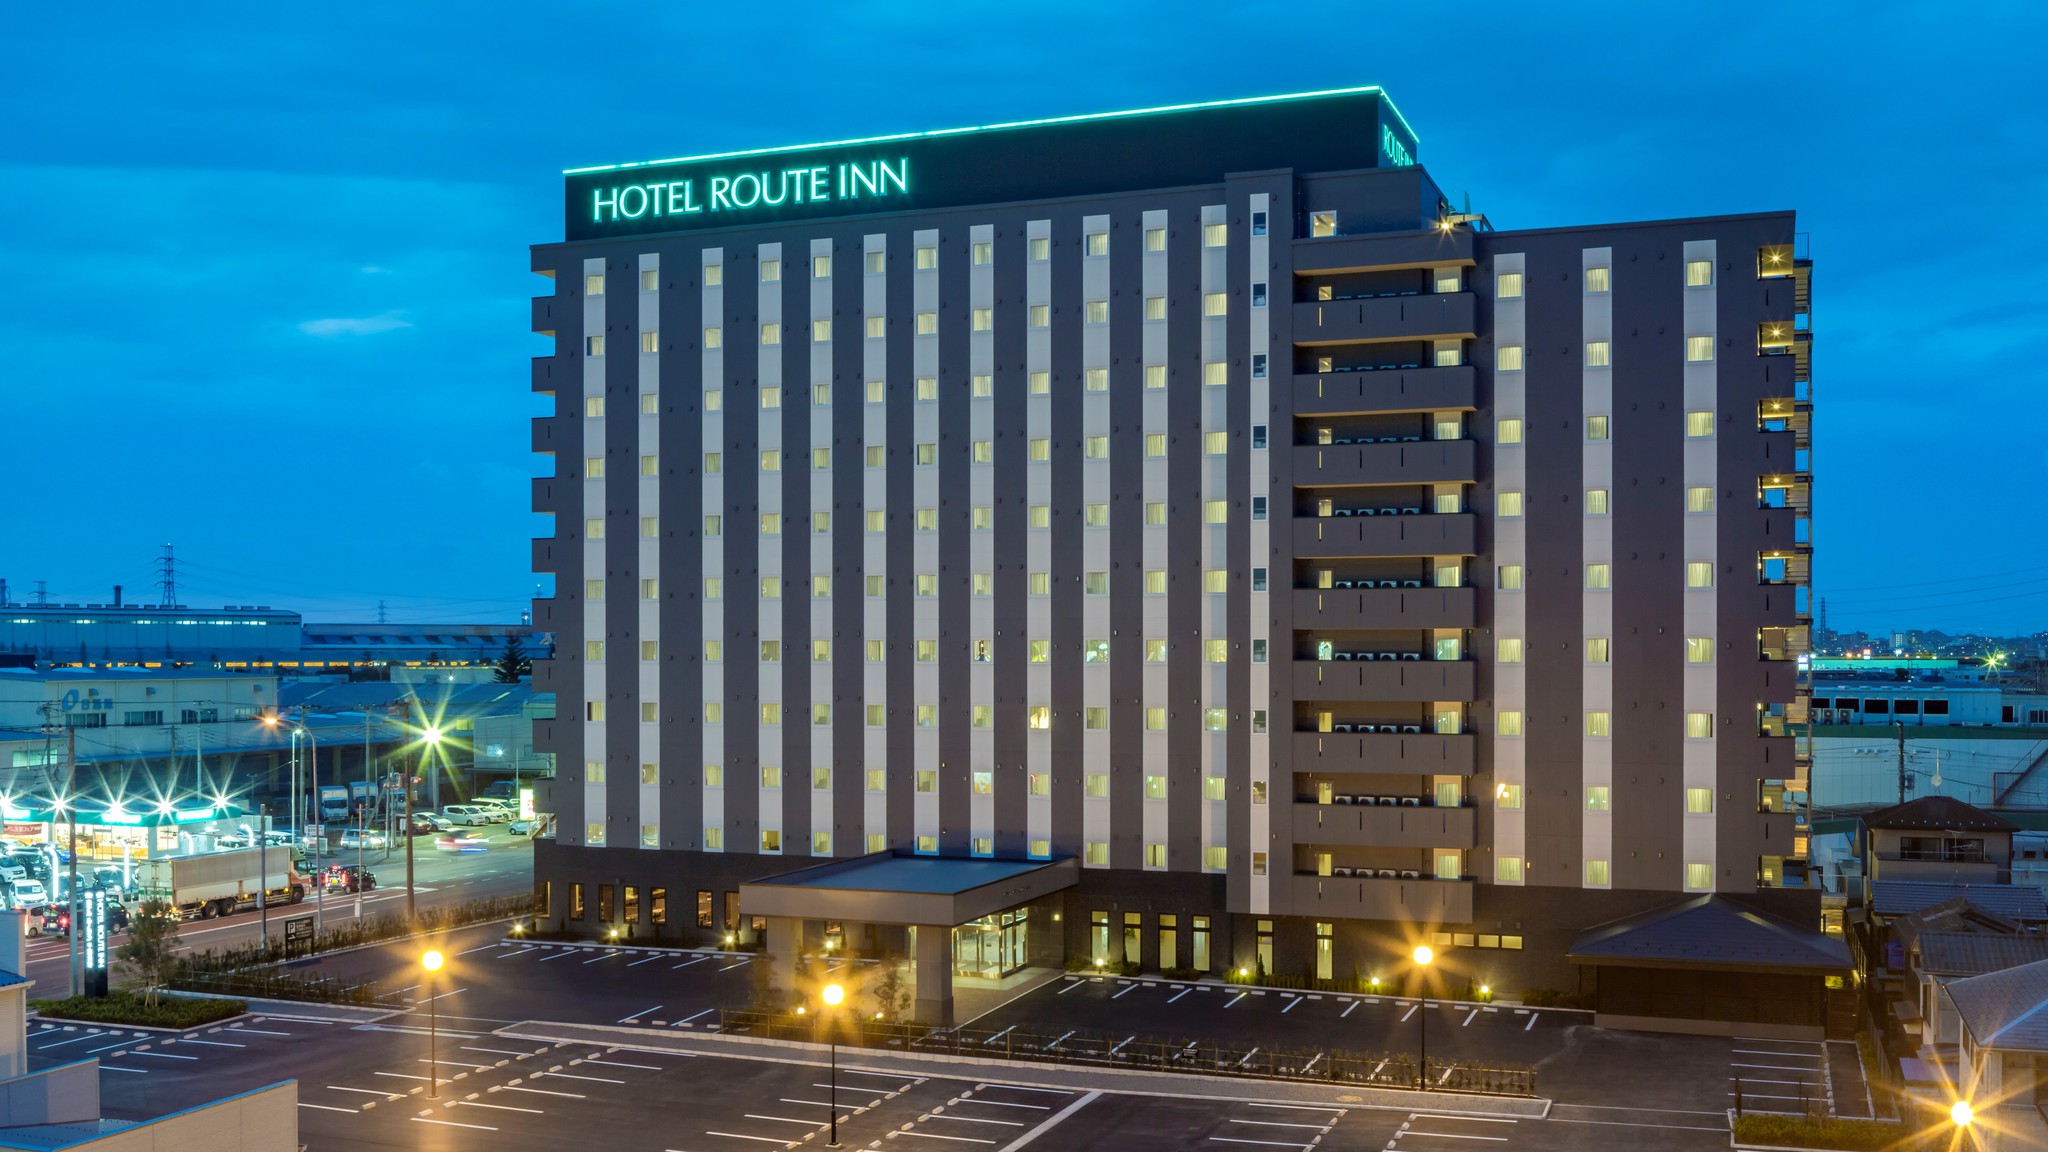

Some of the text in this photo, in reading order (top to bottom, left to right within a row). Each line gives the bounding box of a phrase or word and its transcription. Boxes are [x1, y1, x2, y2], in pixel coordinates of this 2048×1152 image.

[594, 157, 908, 223] HOTEL ROUTE INN
[96, 898, 105, 968] HOTEL ROUTE INN
